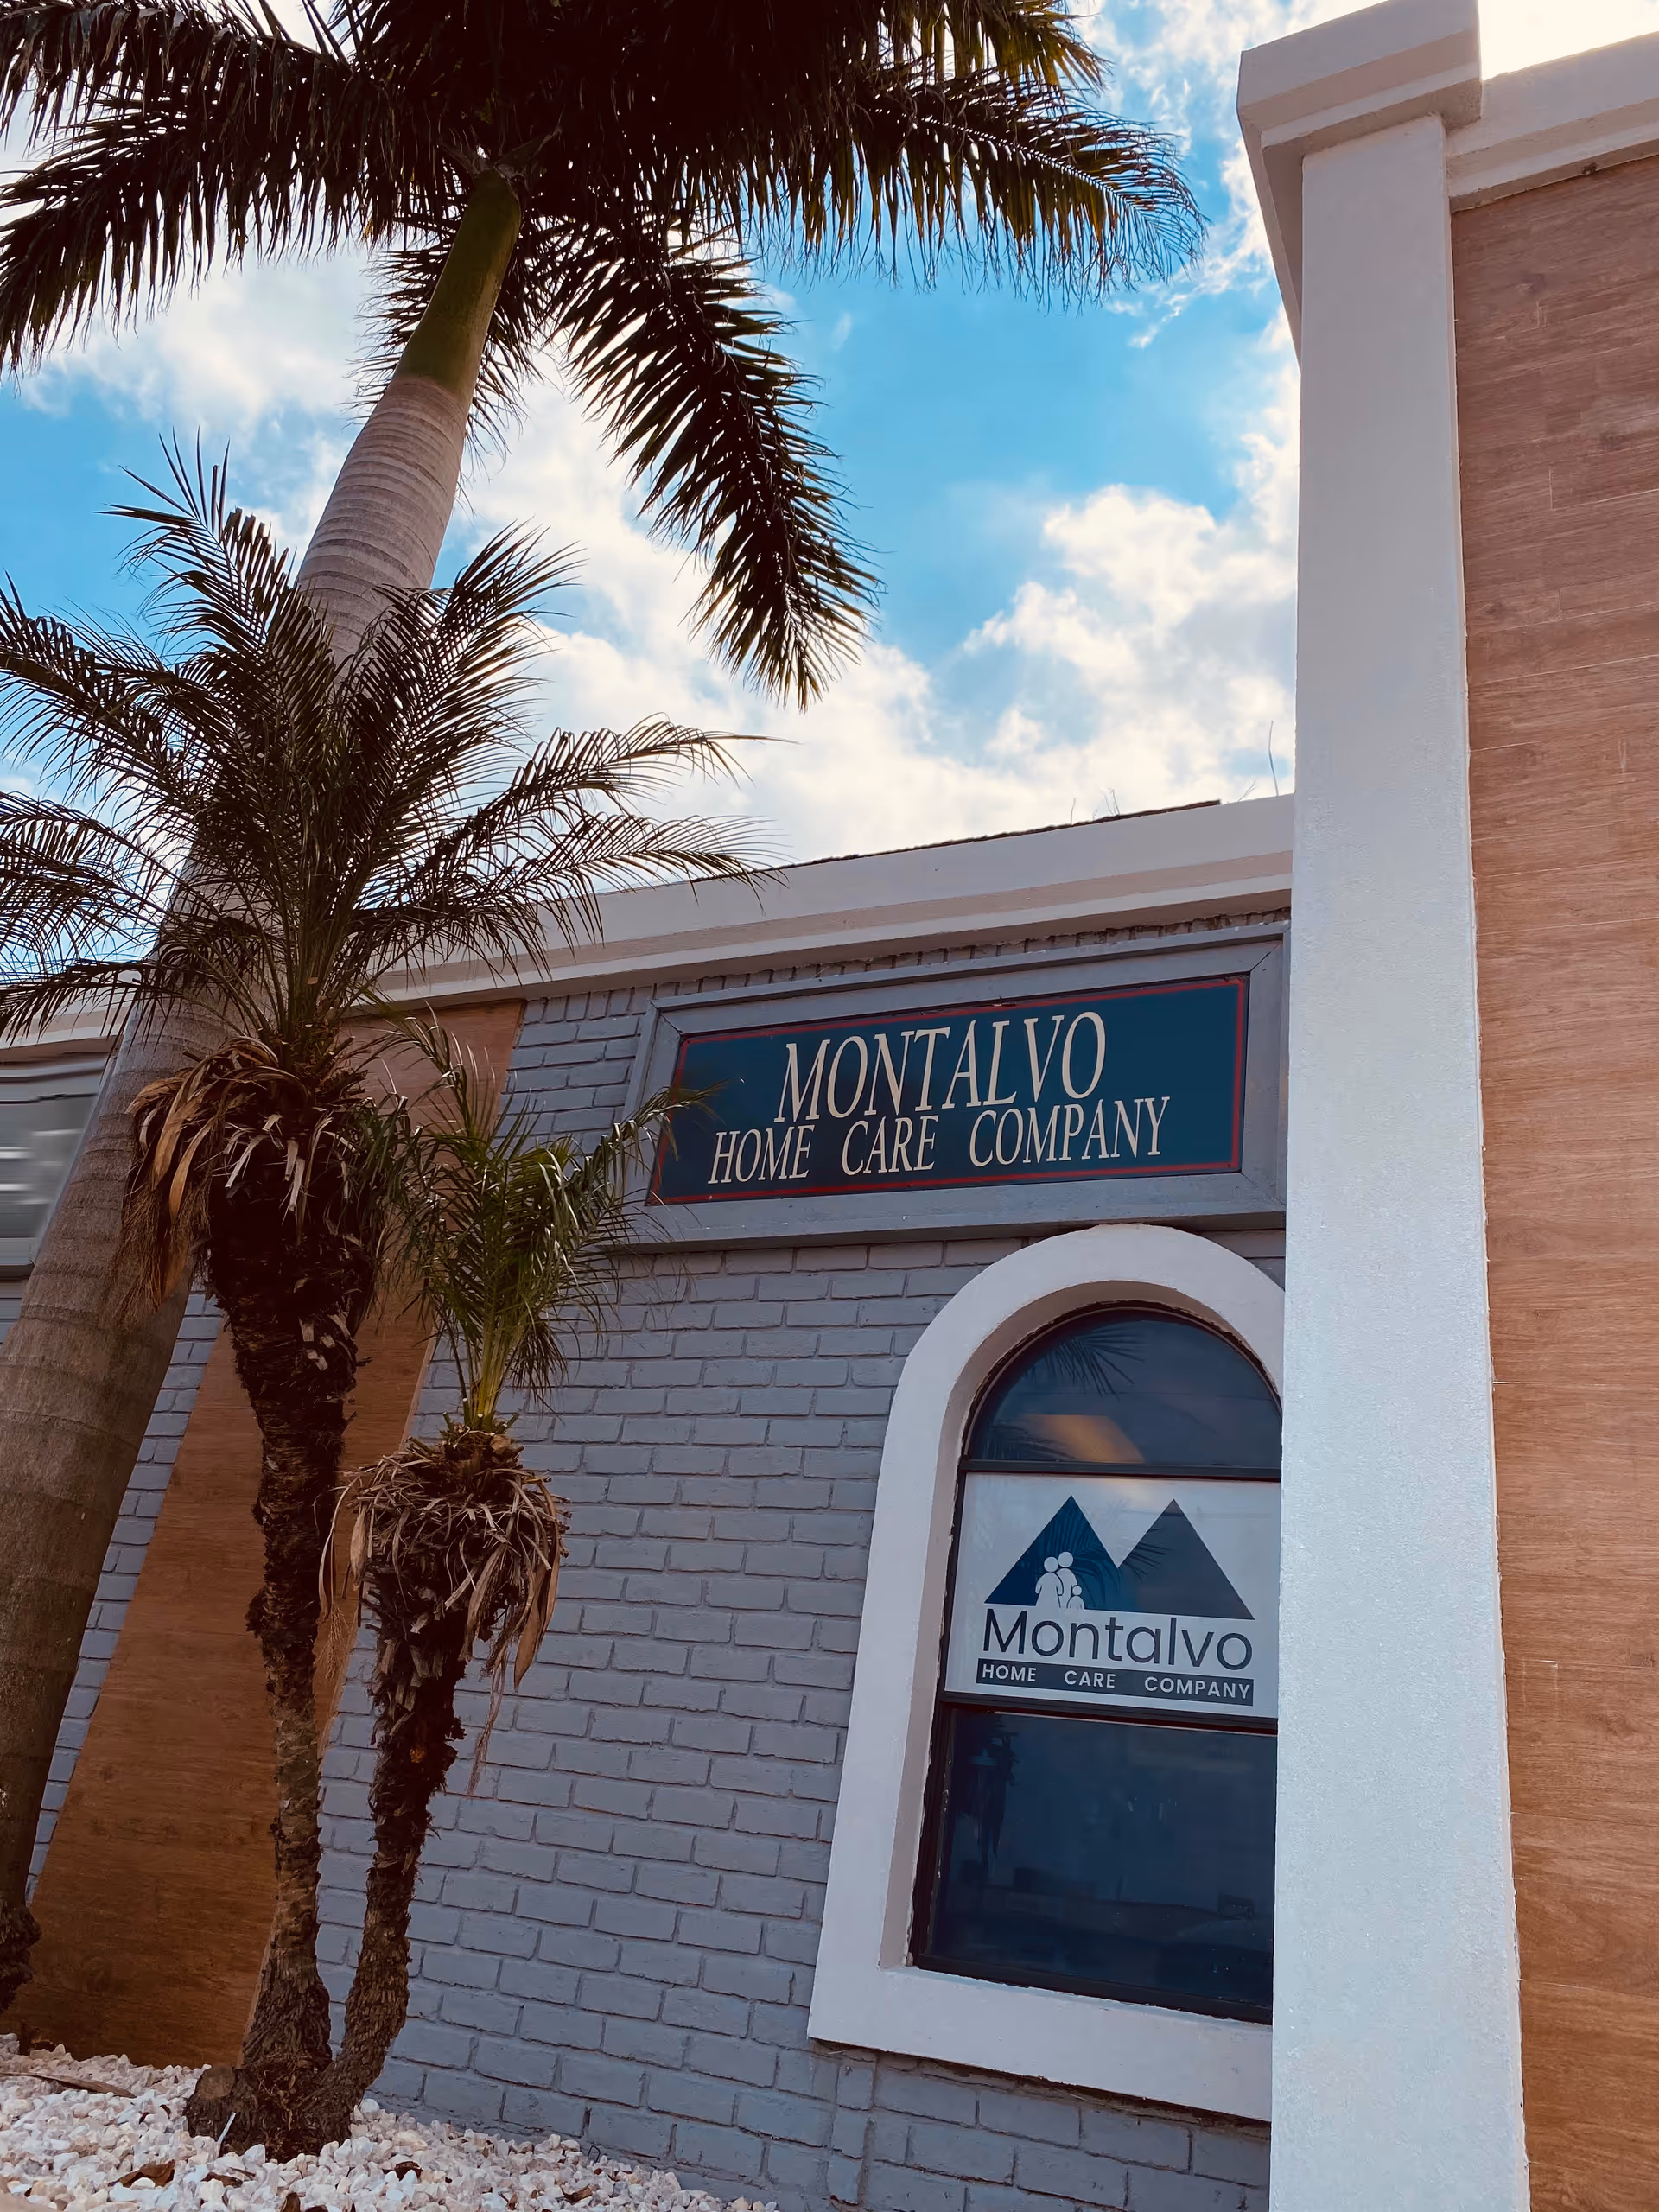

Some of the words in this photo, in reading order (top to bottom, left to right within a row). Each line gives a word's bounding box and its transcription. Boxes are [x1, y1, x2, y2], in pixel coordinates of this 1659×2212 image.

[774, 1011, 1106, 1123] MONTALVO
[707, 1125, 816, 1185] HOME
[842, 1116, 939, 1176] CARE
[969, 1096, 1171, 1167] COMPANY
[982, 1608, 1253, 1670] Montalvo
[982, 1663, 1037, 1682] HOME
[1064, 1669, 1116, 1688] CARE
[1144, 1676, 1251, 1700] COMPANY
